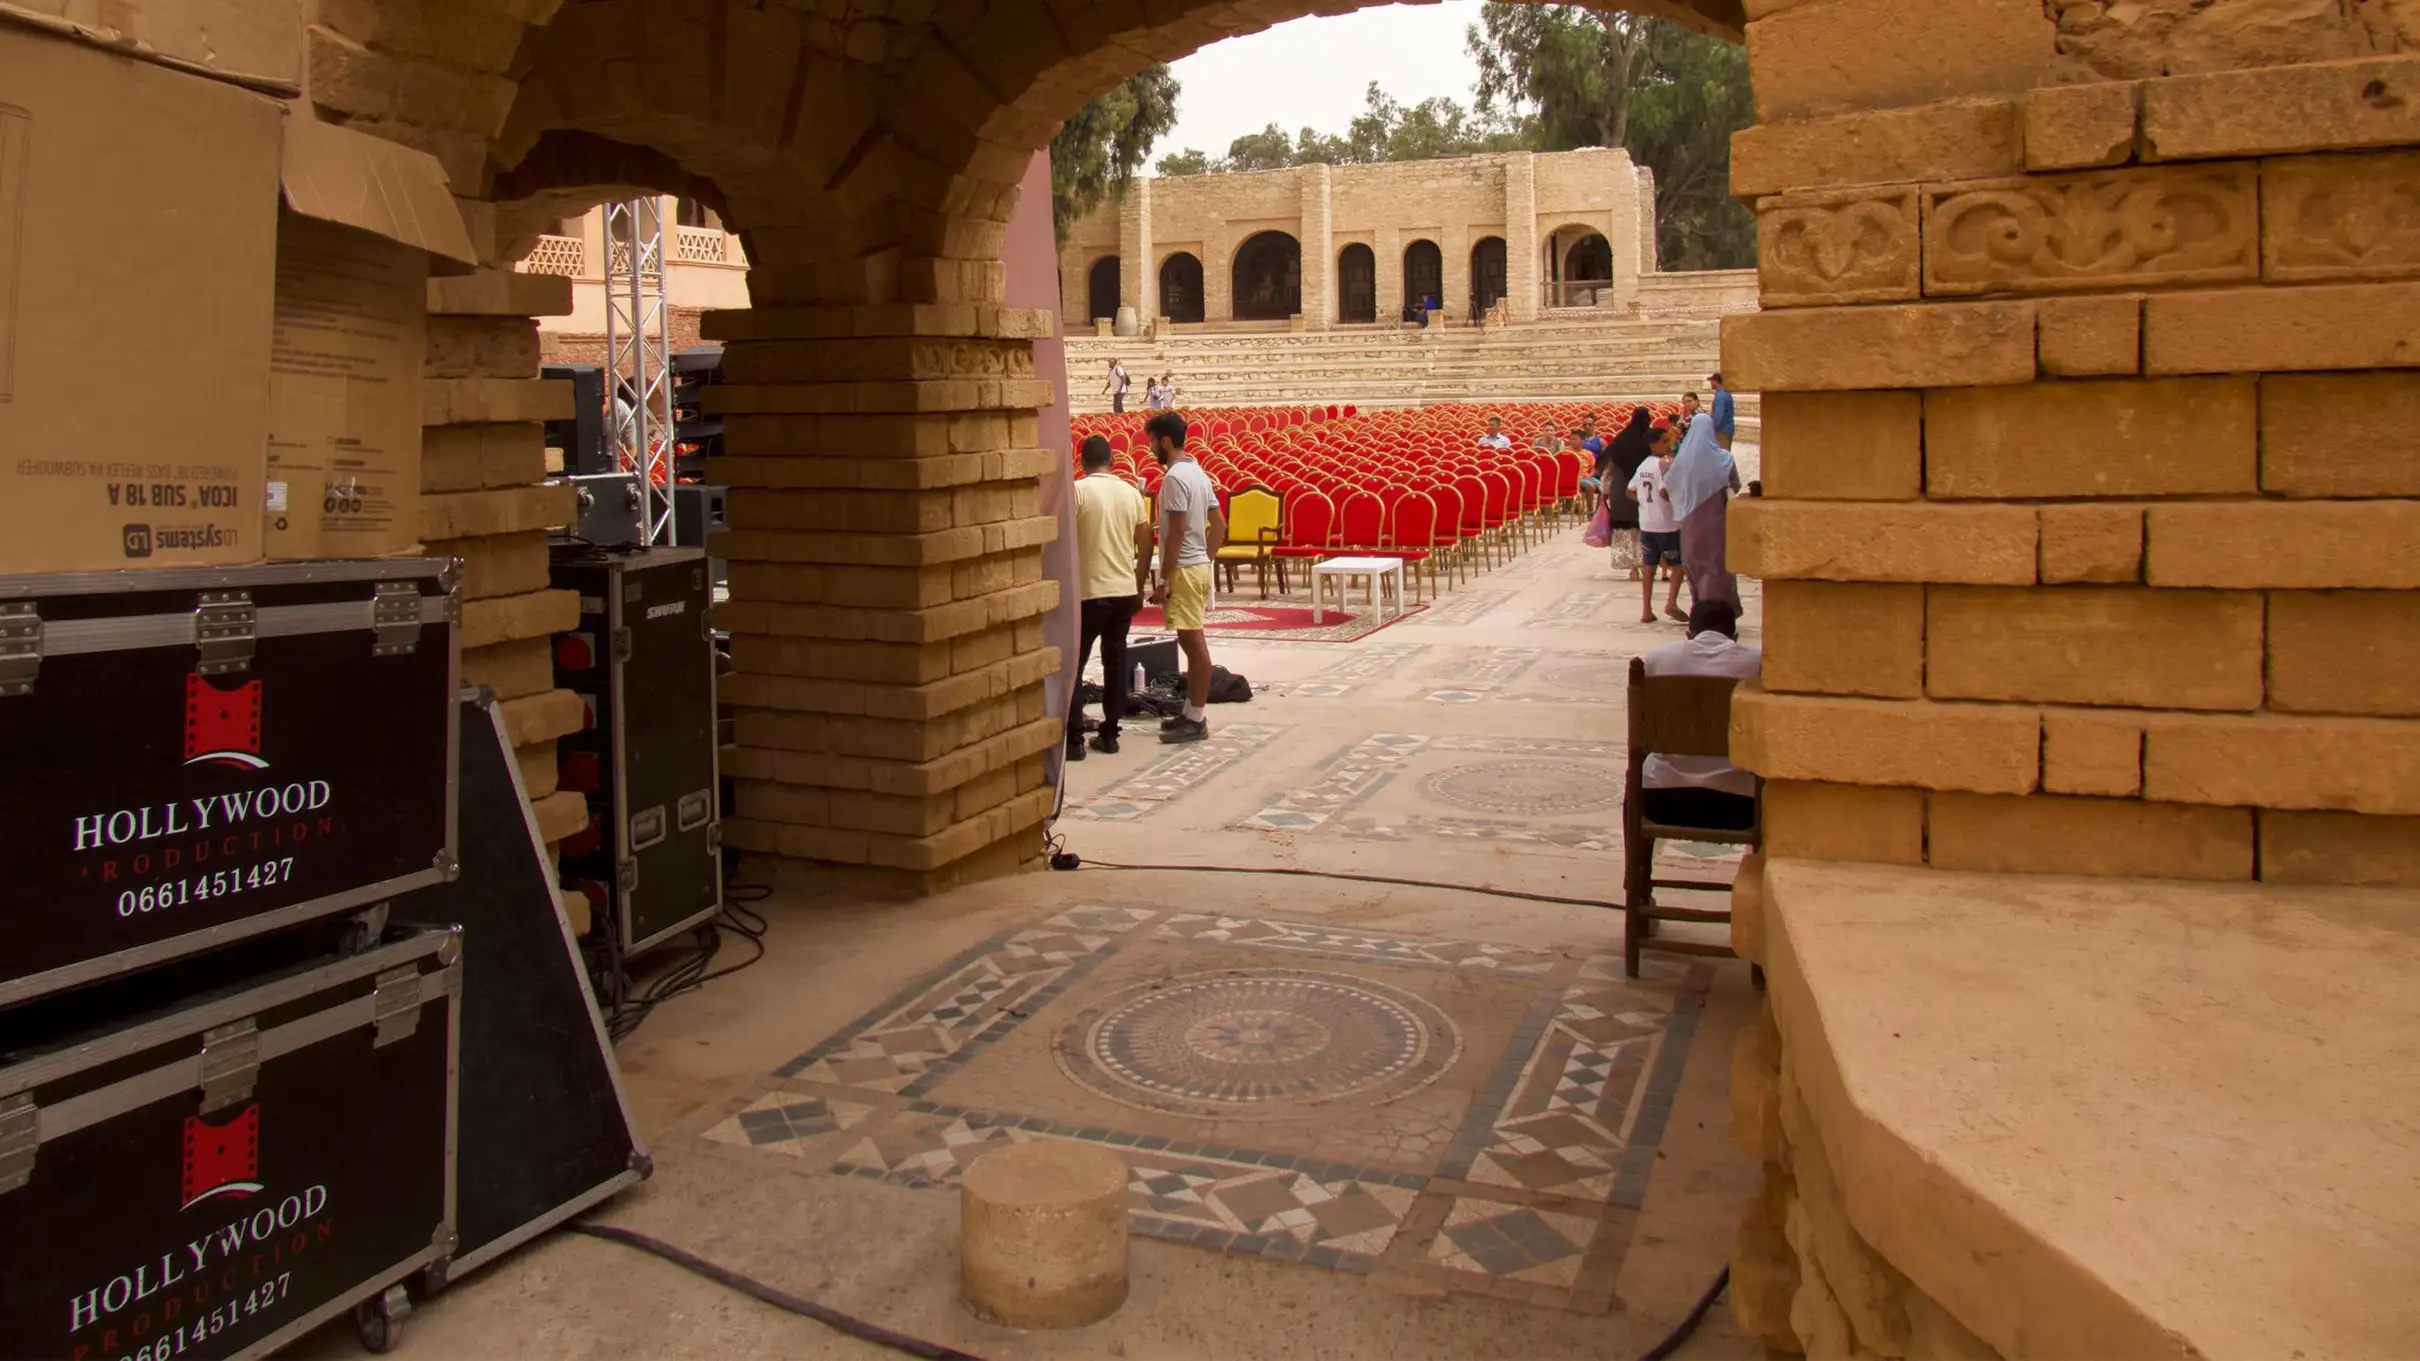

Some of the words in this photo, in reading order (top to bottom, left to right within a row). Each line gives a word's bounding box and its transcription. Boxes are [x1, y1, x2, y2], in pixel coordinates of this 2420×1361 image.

[17, 459, 86, 476] SUBWOOFER
[88, 461, 103, 477] PA
[107, 462, 144, 478] REFLEX
[146, 464, 171, 479] BASS
[192, 466, 238, 480] POWERED
[107, 483, 120, 505] A
[126, 484, 147, 506] 18
[152, 485, 186, 506] SUB
[1643, 481, 1653, 503] 7
[127, 532, 148, 550] LD
[646, 601, 686, 619] SHURE
[73, 780, 331, 851] HOLLYWOOD
[80, 817, 332, 881] RODUCTION
[118, 857, 294, 917] 0661451427
[69, 1184, 327, 1333] HOLLYWOOD
[120, 1272, 291, 1361] 661451427
